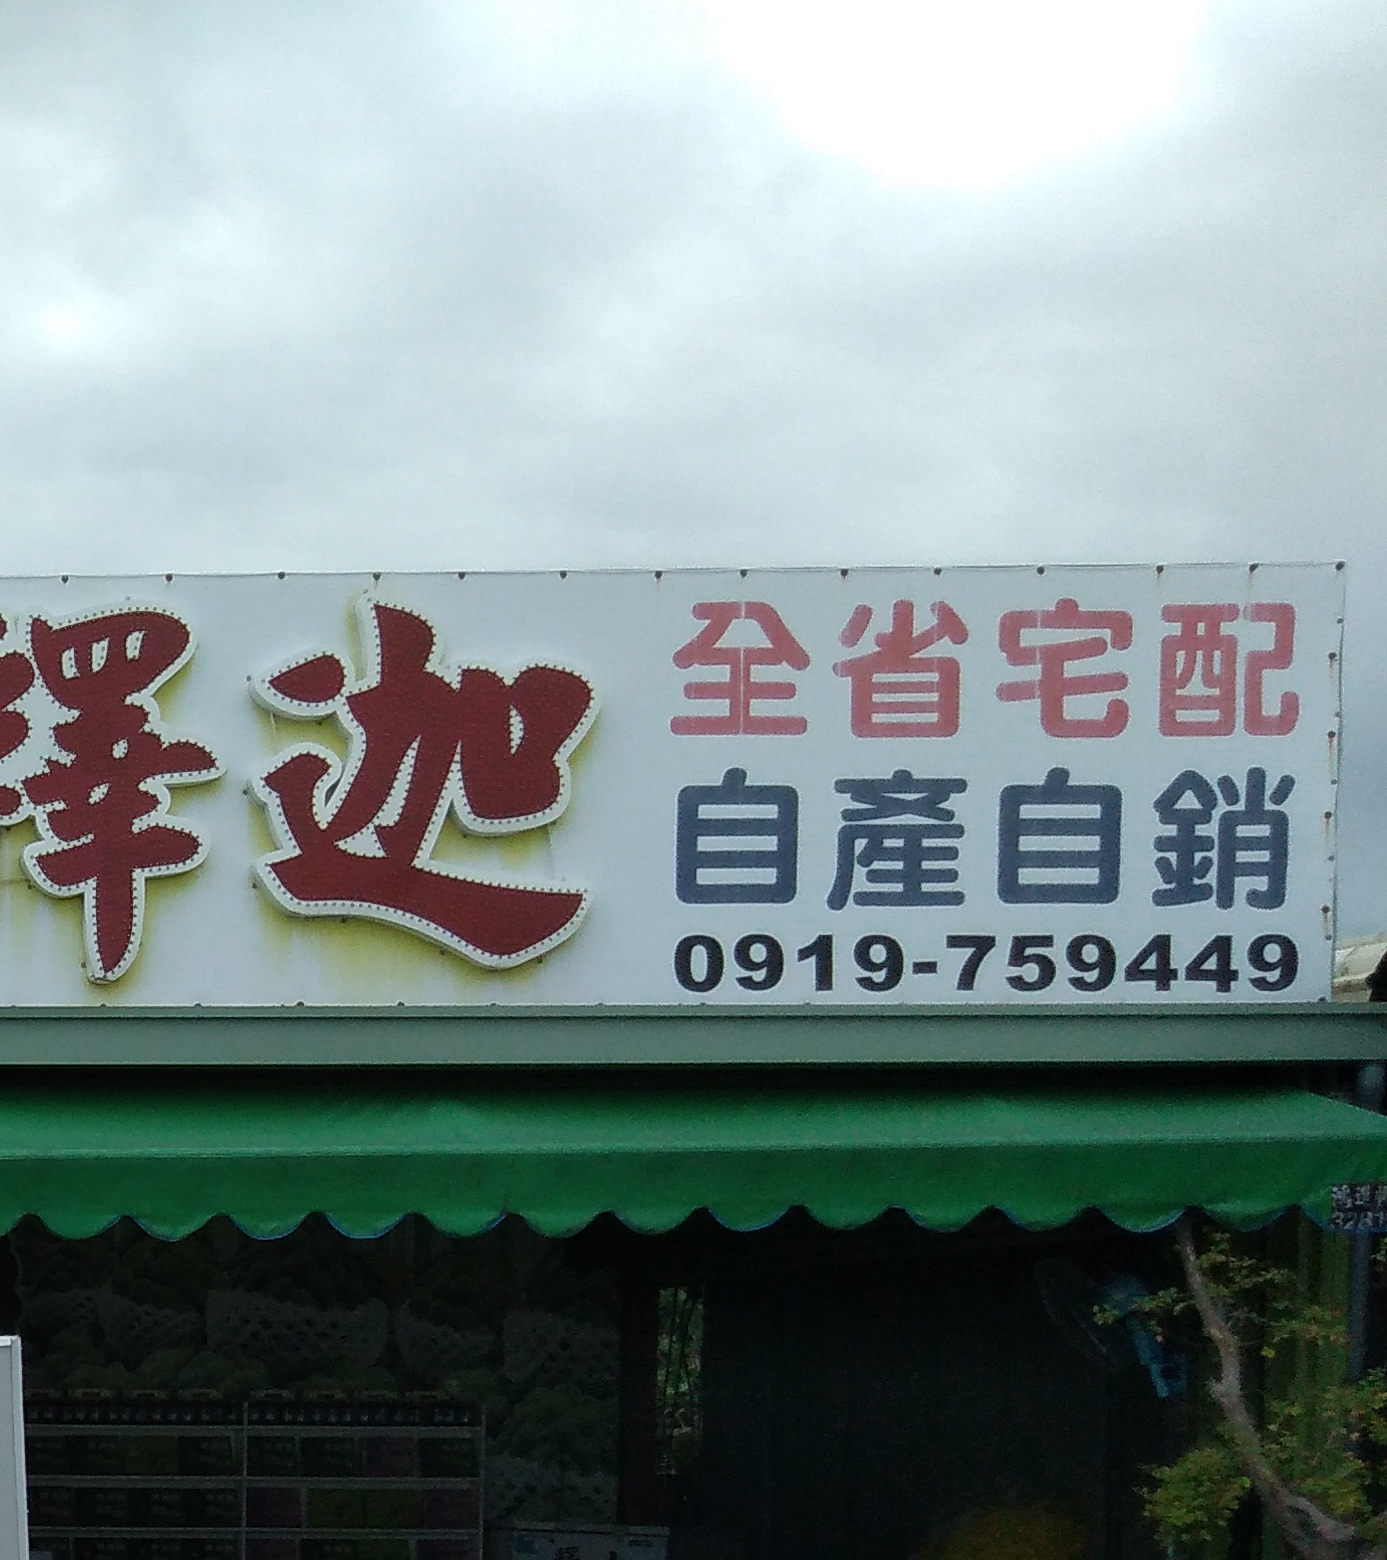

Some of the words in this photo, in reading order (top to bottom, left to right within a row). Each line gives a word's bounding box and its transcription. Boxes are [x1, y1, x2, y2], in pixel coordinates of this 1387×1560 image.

[670, 598, 1301, 739] 全省宅配
[673, 766, 1297, 912] 自產自銷
[674, 933, 1300, 994] 0919-759449
